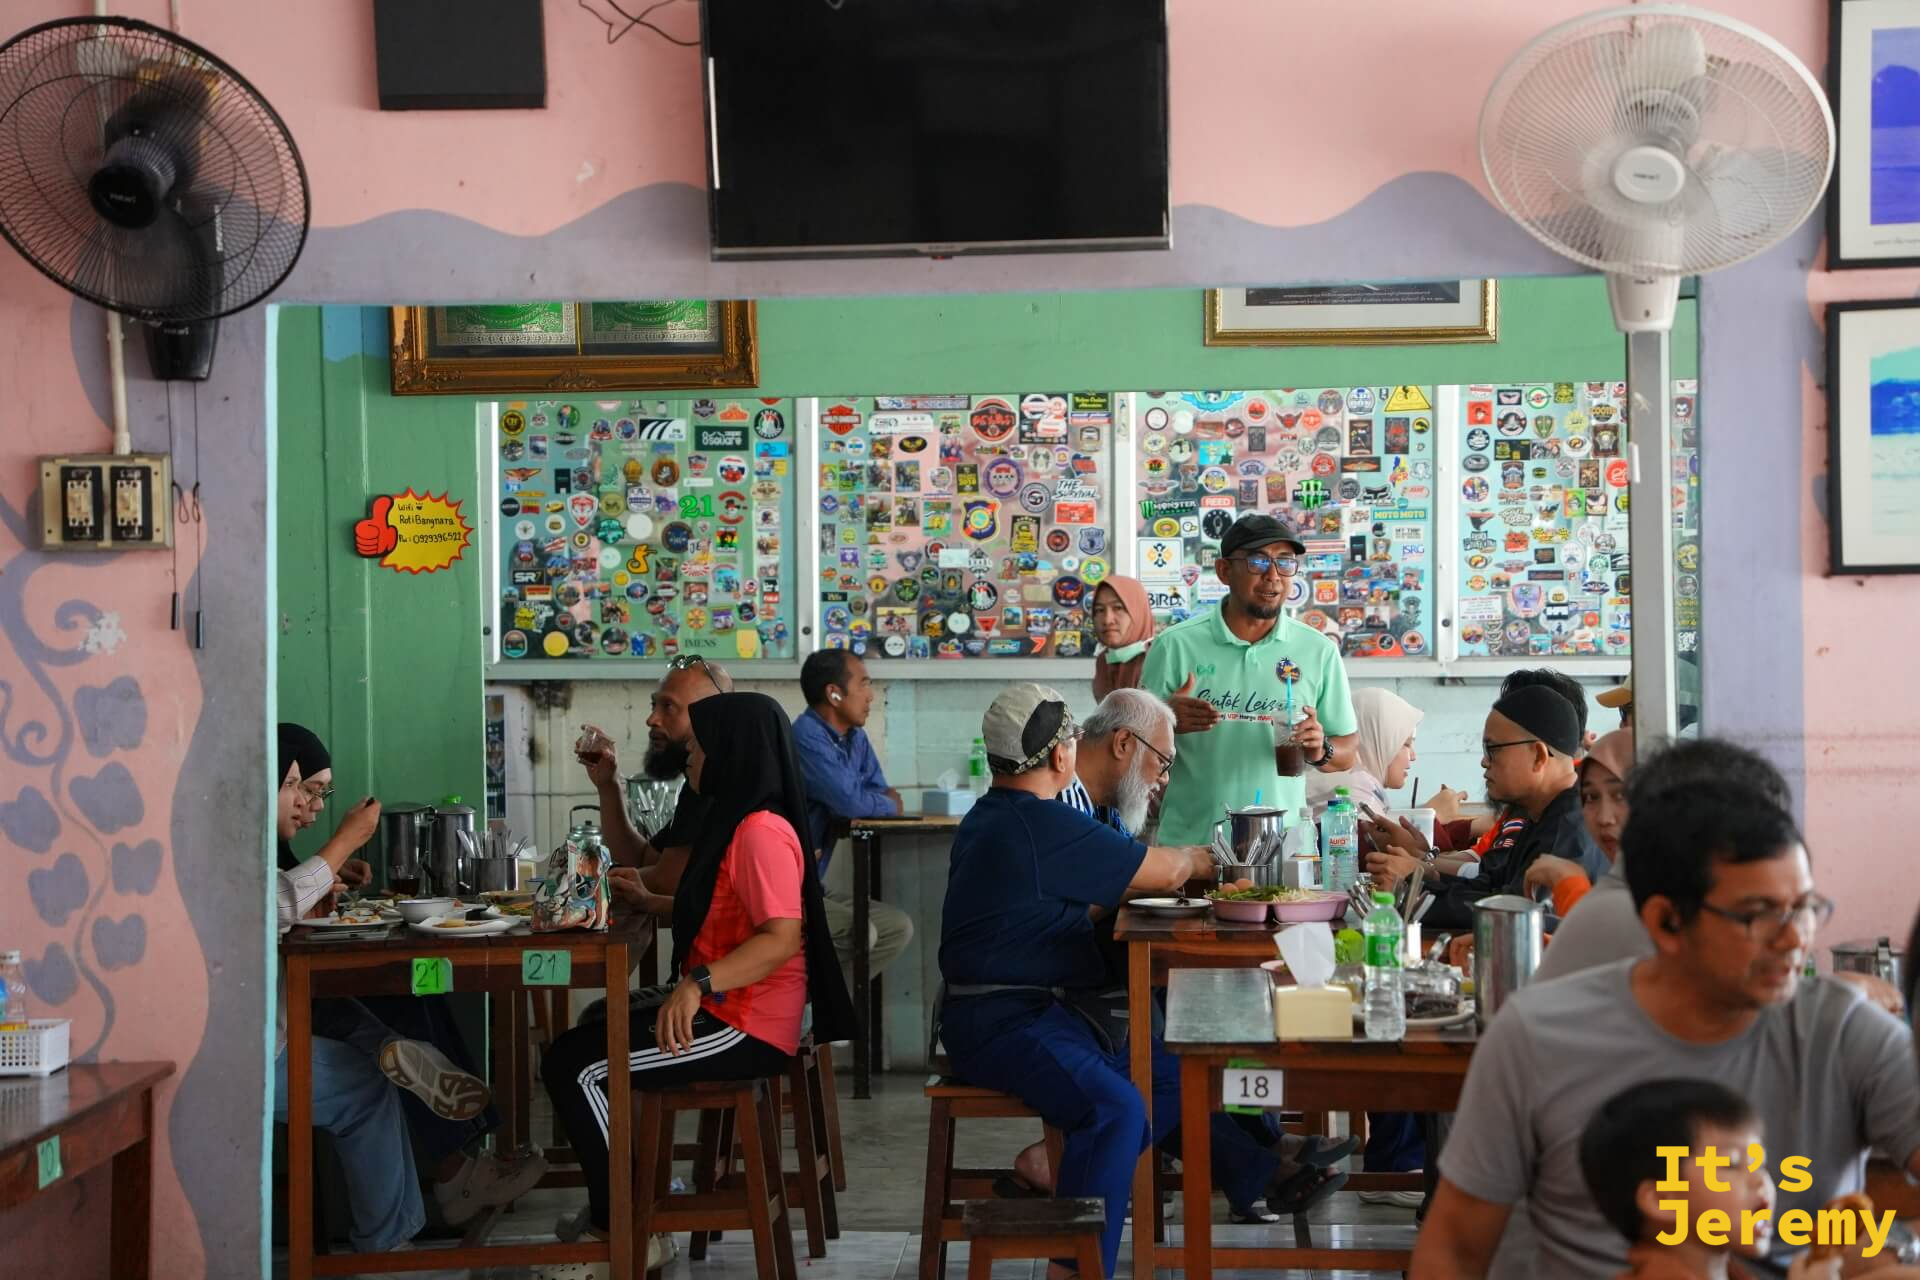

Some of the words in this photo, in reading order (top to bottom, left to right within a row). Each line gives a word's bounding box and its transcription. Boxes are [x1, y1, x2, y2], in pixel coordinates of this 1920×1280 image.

[679, 494, 715, 519] 21
[415, 959, 440, 989] 21
[528, 953, 557, 981] 21
[1240, 1075, 1269, 1098] 18
